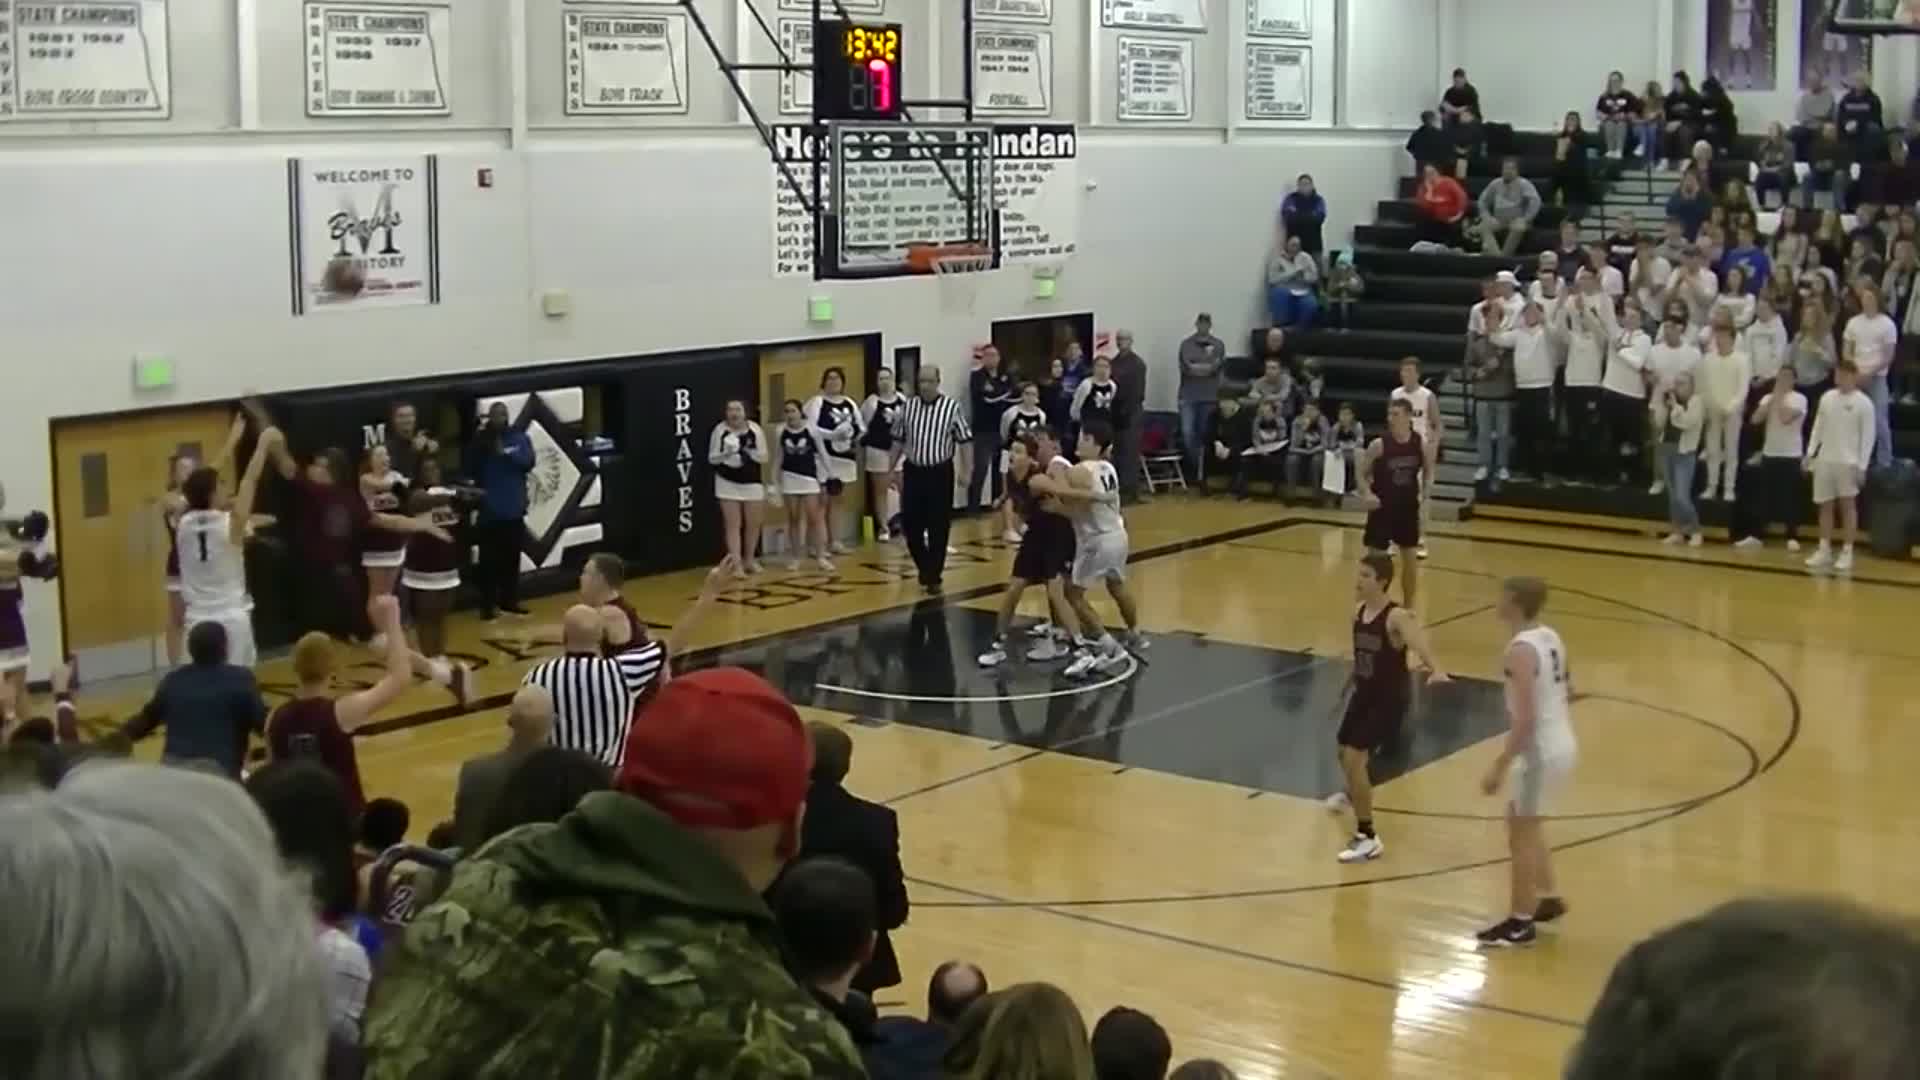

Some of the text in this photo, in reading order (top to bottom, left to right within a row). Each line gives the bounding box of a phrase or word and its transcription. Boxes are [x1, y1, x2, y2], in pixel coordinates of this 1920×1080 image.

[846, 27, 897, 60] 13:42
[629, 88, 663, 101] TRACK
[314, 168, 414, 183] WELCOME TO
[675, 388, 693, 533] BRAVES
[195, 530, 208, 563] 1
